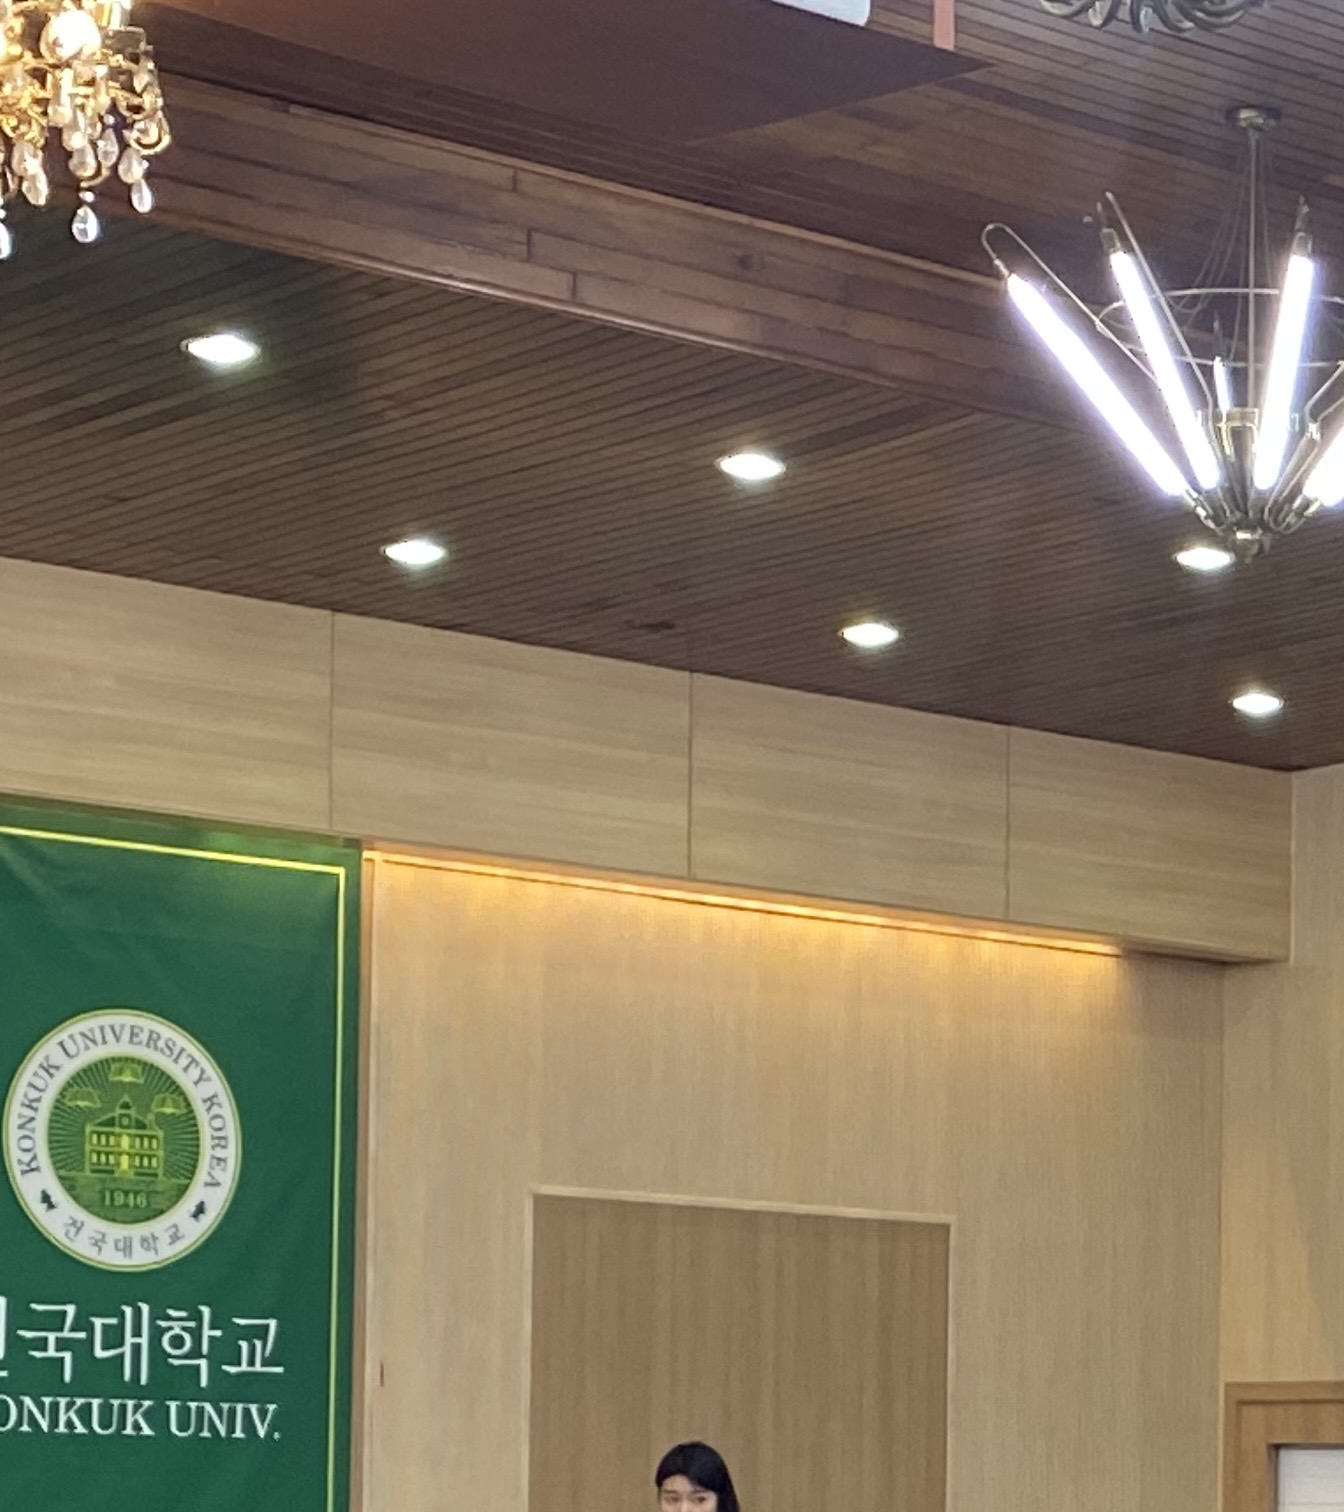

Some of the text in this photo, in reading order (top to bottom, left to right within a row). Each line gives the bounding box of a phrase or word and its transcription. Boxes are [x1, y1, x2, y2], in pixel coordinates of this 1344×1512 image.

[17, 1024, 229, 1188] KONKUK UNIVERSITY KOREA
[103, 1190, 147, 1208] 1946
[165, 1400, 281, 1441] UNIV.
